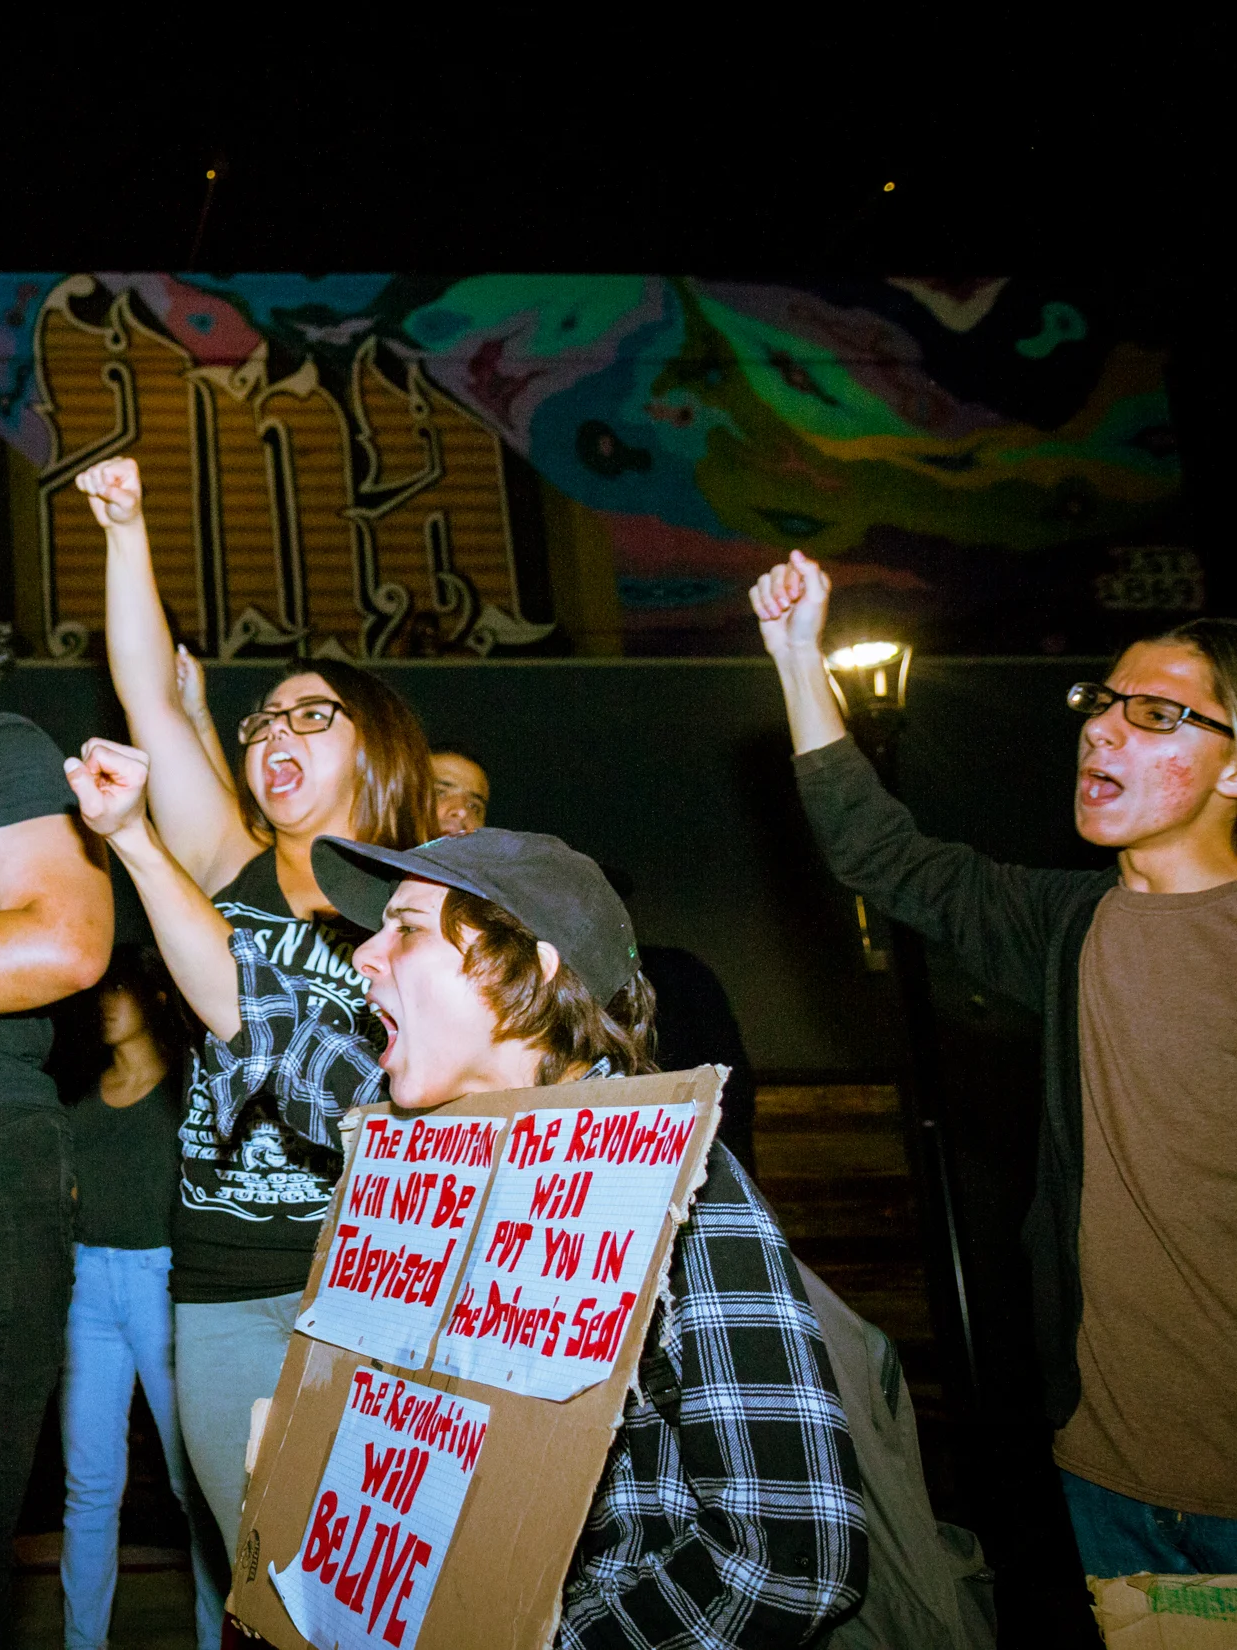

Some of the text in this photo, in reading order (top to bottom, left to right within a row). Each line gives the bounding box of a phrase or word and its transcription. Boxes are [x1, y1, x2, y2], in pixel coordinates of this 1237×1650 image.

[509, 1114, 562, 1169] The
[328, 1224, 457, 1307] Televised
[485, 1219, 636, 1285] PUT YOU IN
